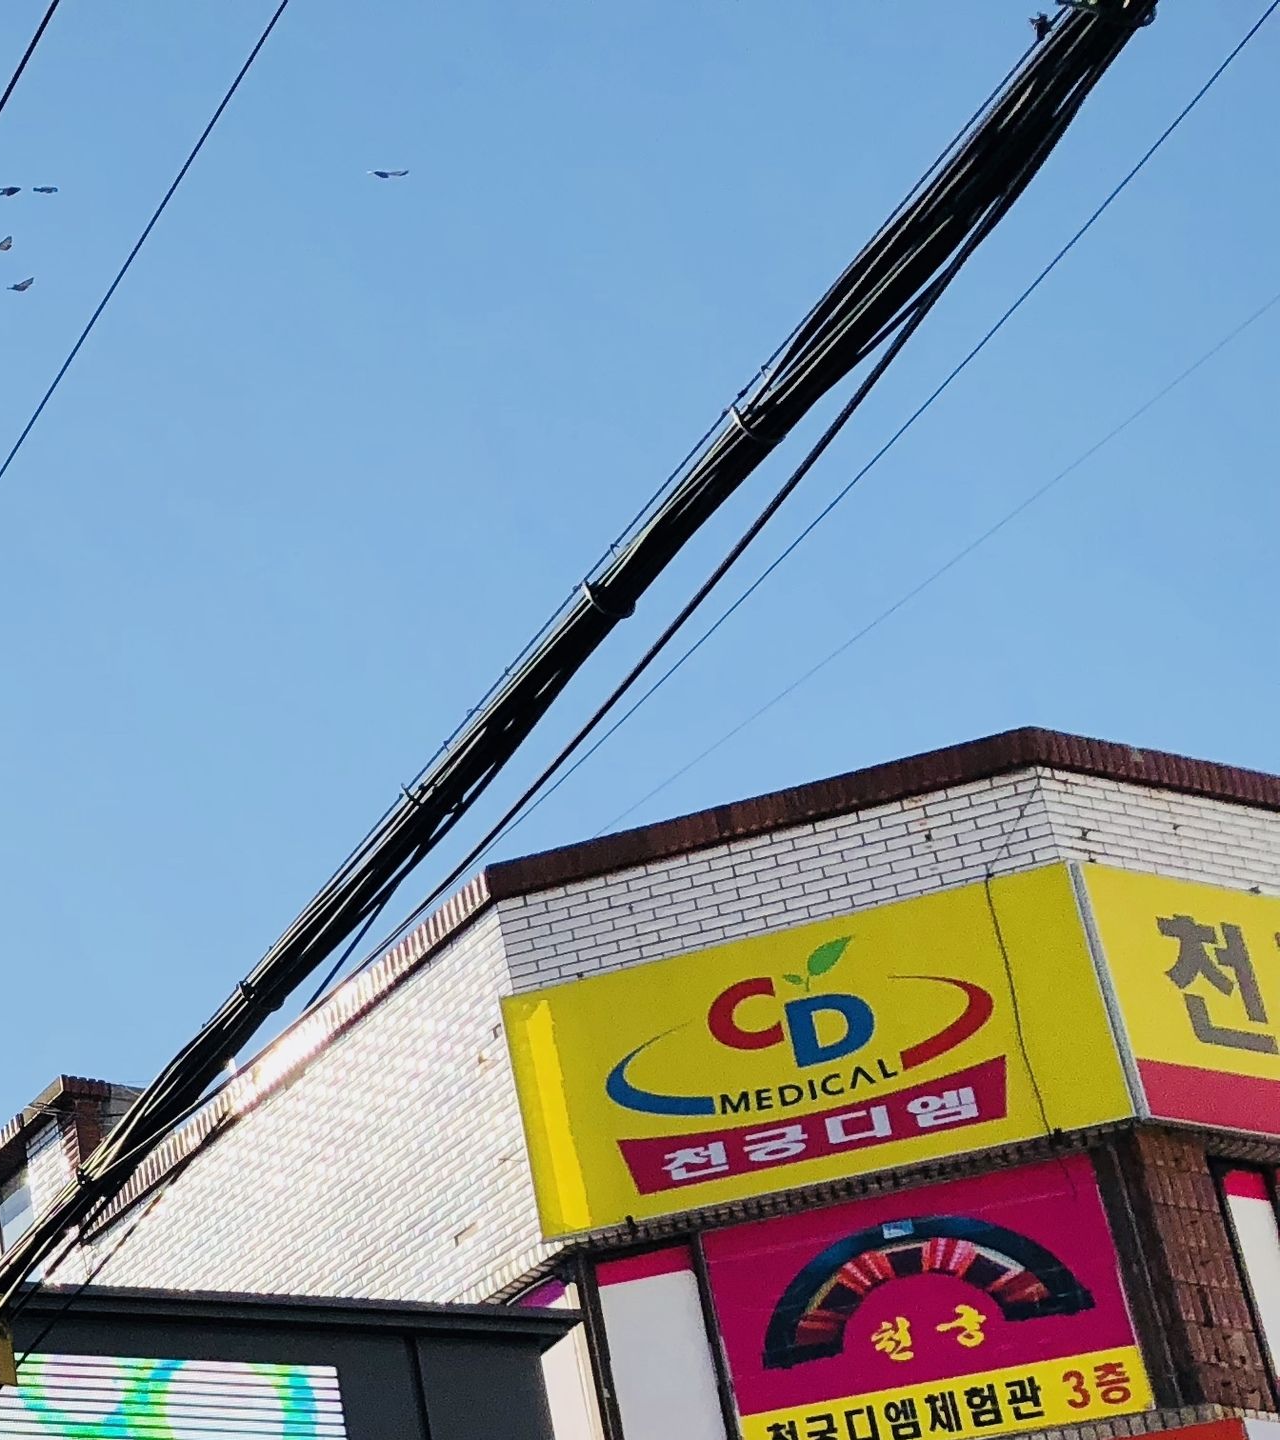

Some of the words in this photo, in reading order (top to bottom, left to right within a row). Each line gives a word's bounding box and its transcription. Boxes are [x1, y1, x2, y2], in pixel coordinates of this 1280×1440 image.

[1156, 912, 1280, 1056] 천
[707, 977, 876, 1068] CD
[719, 1056, 899, 1116] MEDICAL
[662, 1085, 981, 1183] 천궁디엠
[871, 1303, 988, 1361] 천궁
[1060, 1361, 1133, 1410] 3층
